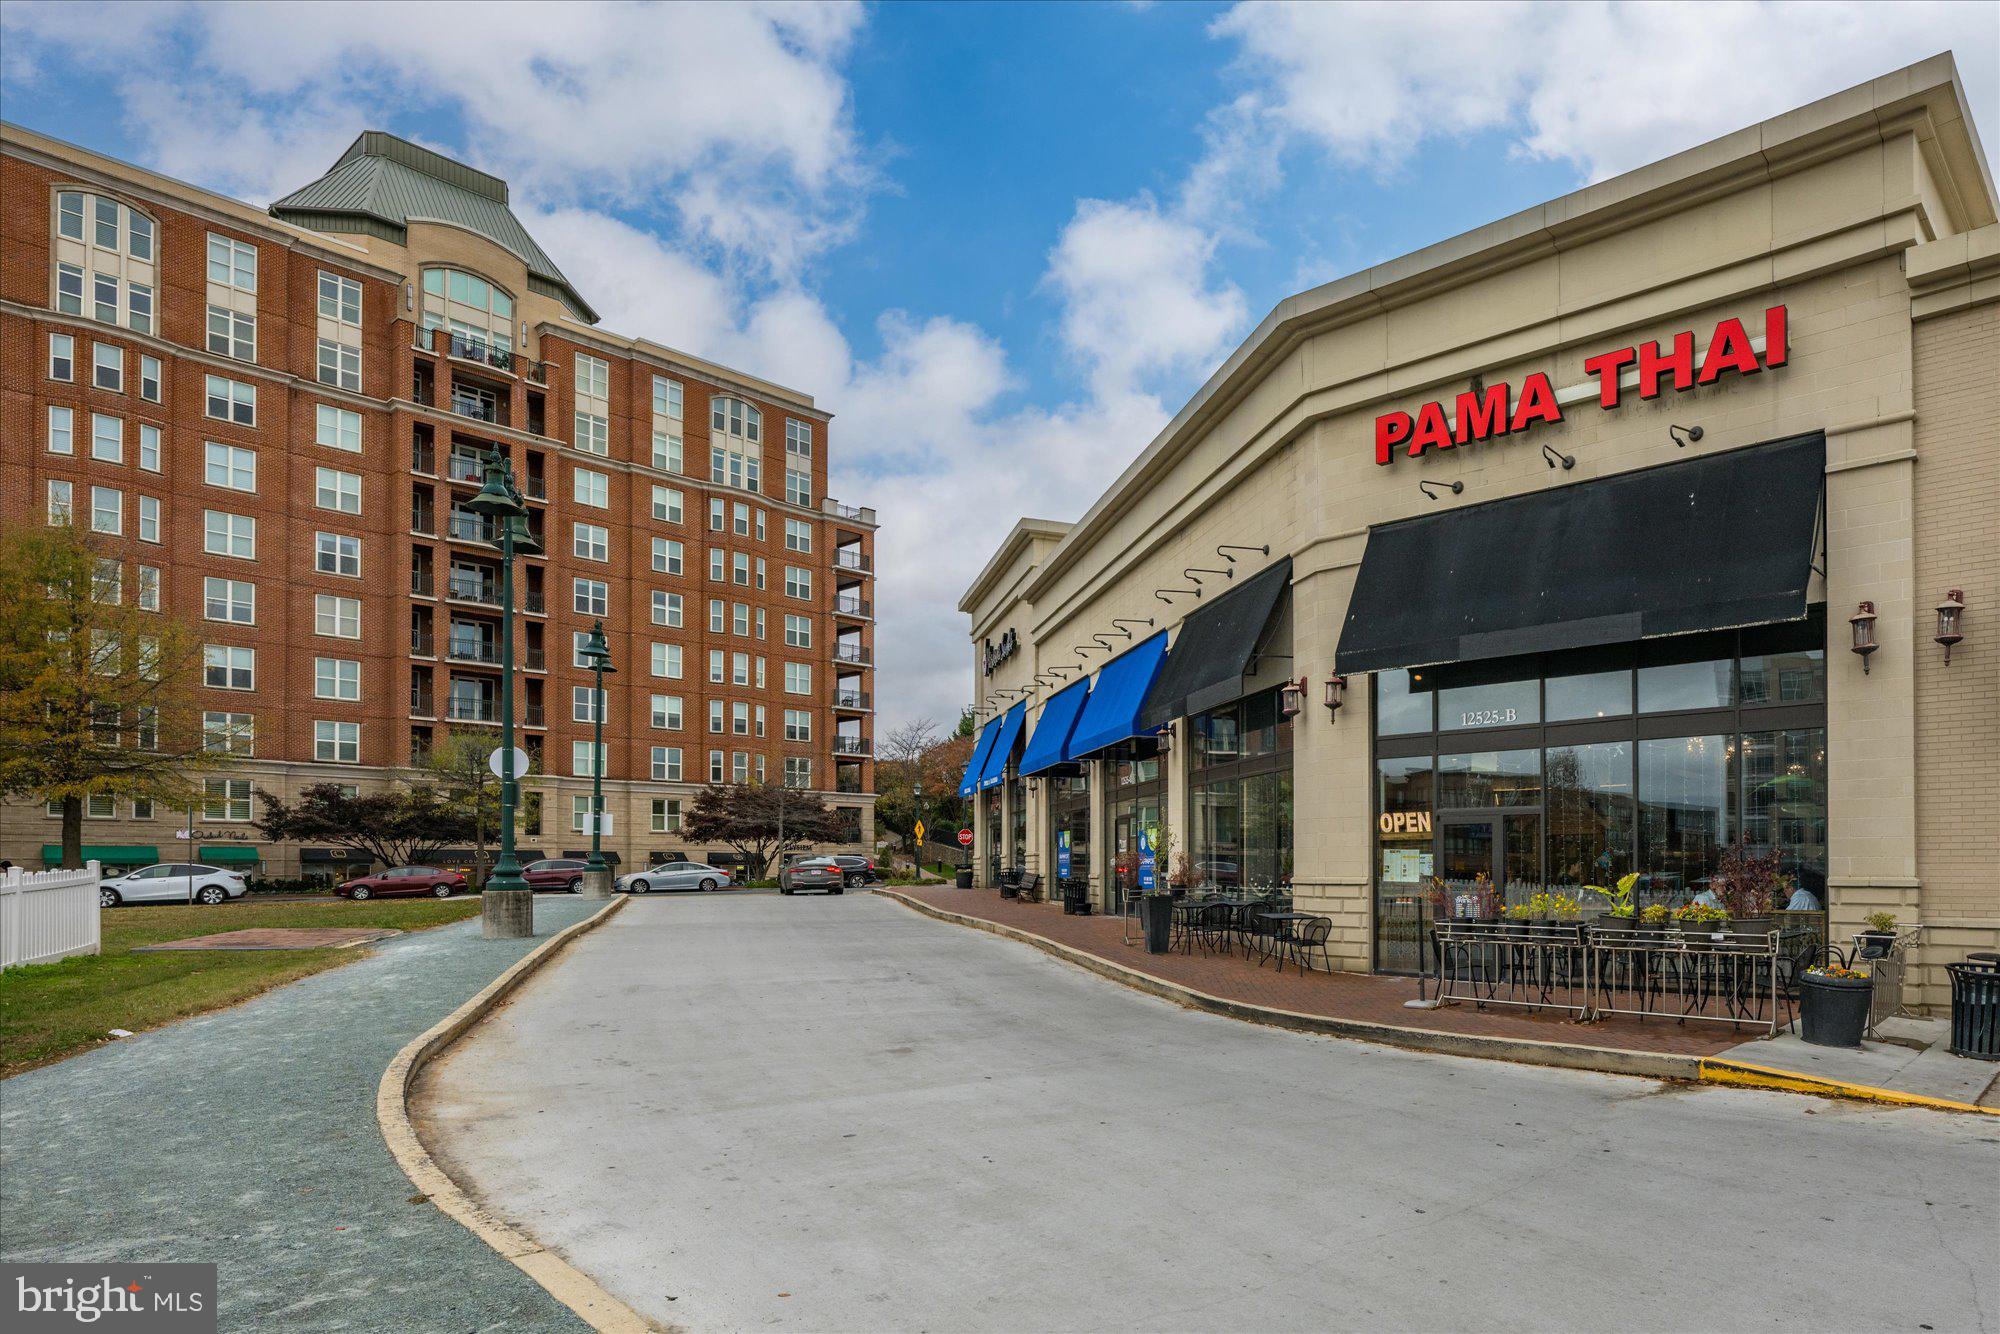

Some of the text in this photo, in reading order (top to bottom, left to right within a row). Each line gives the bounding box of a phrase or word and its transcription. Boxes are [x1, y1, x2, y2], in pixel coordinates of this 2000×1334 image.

[1376, 304, 1788, 466] PAMA THAI
[1460, 708, 1517, 726] 12525-B
[1380, 812, 1431, 833] OPEN
